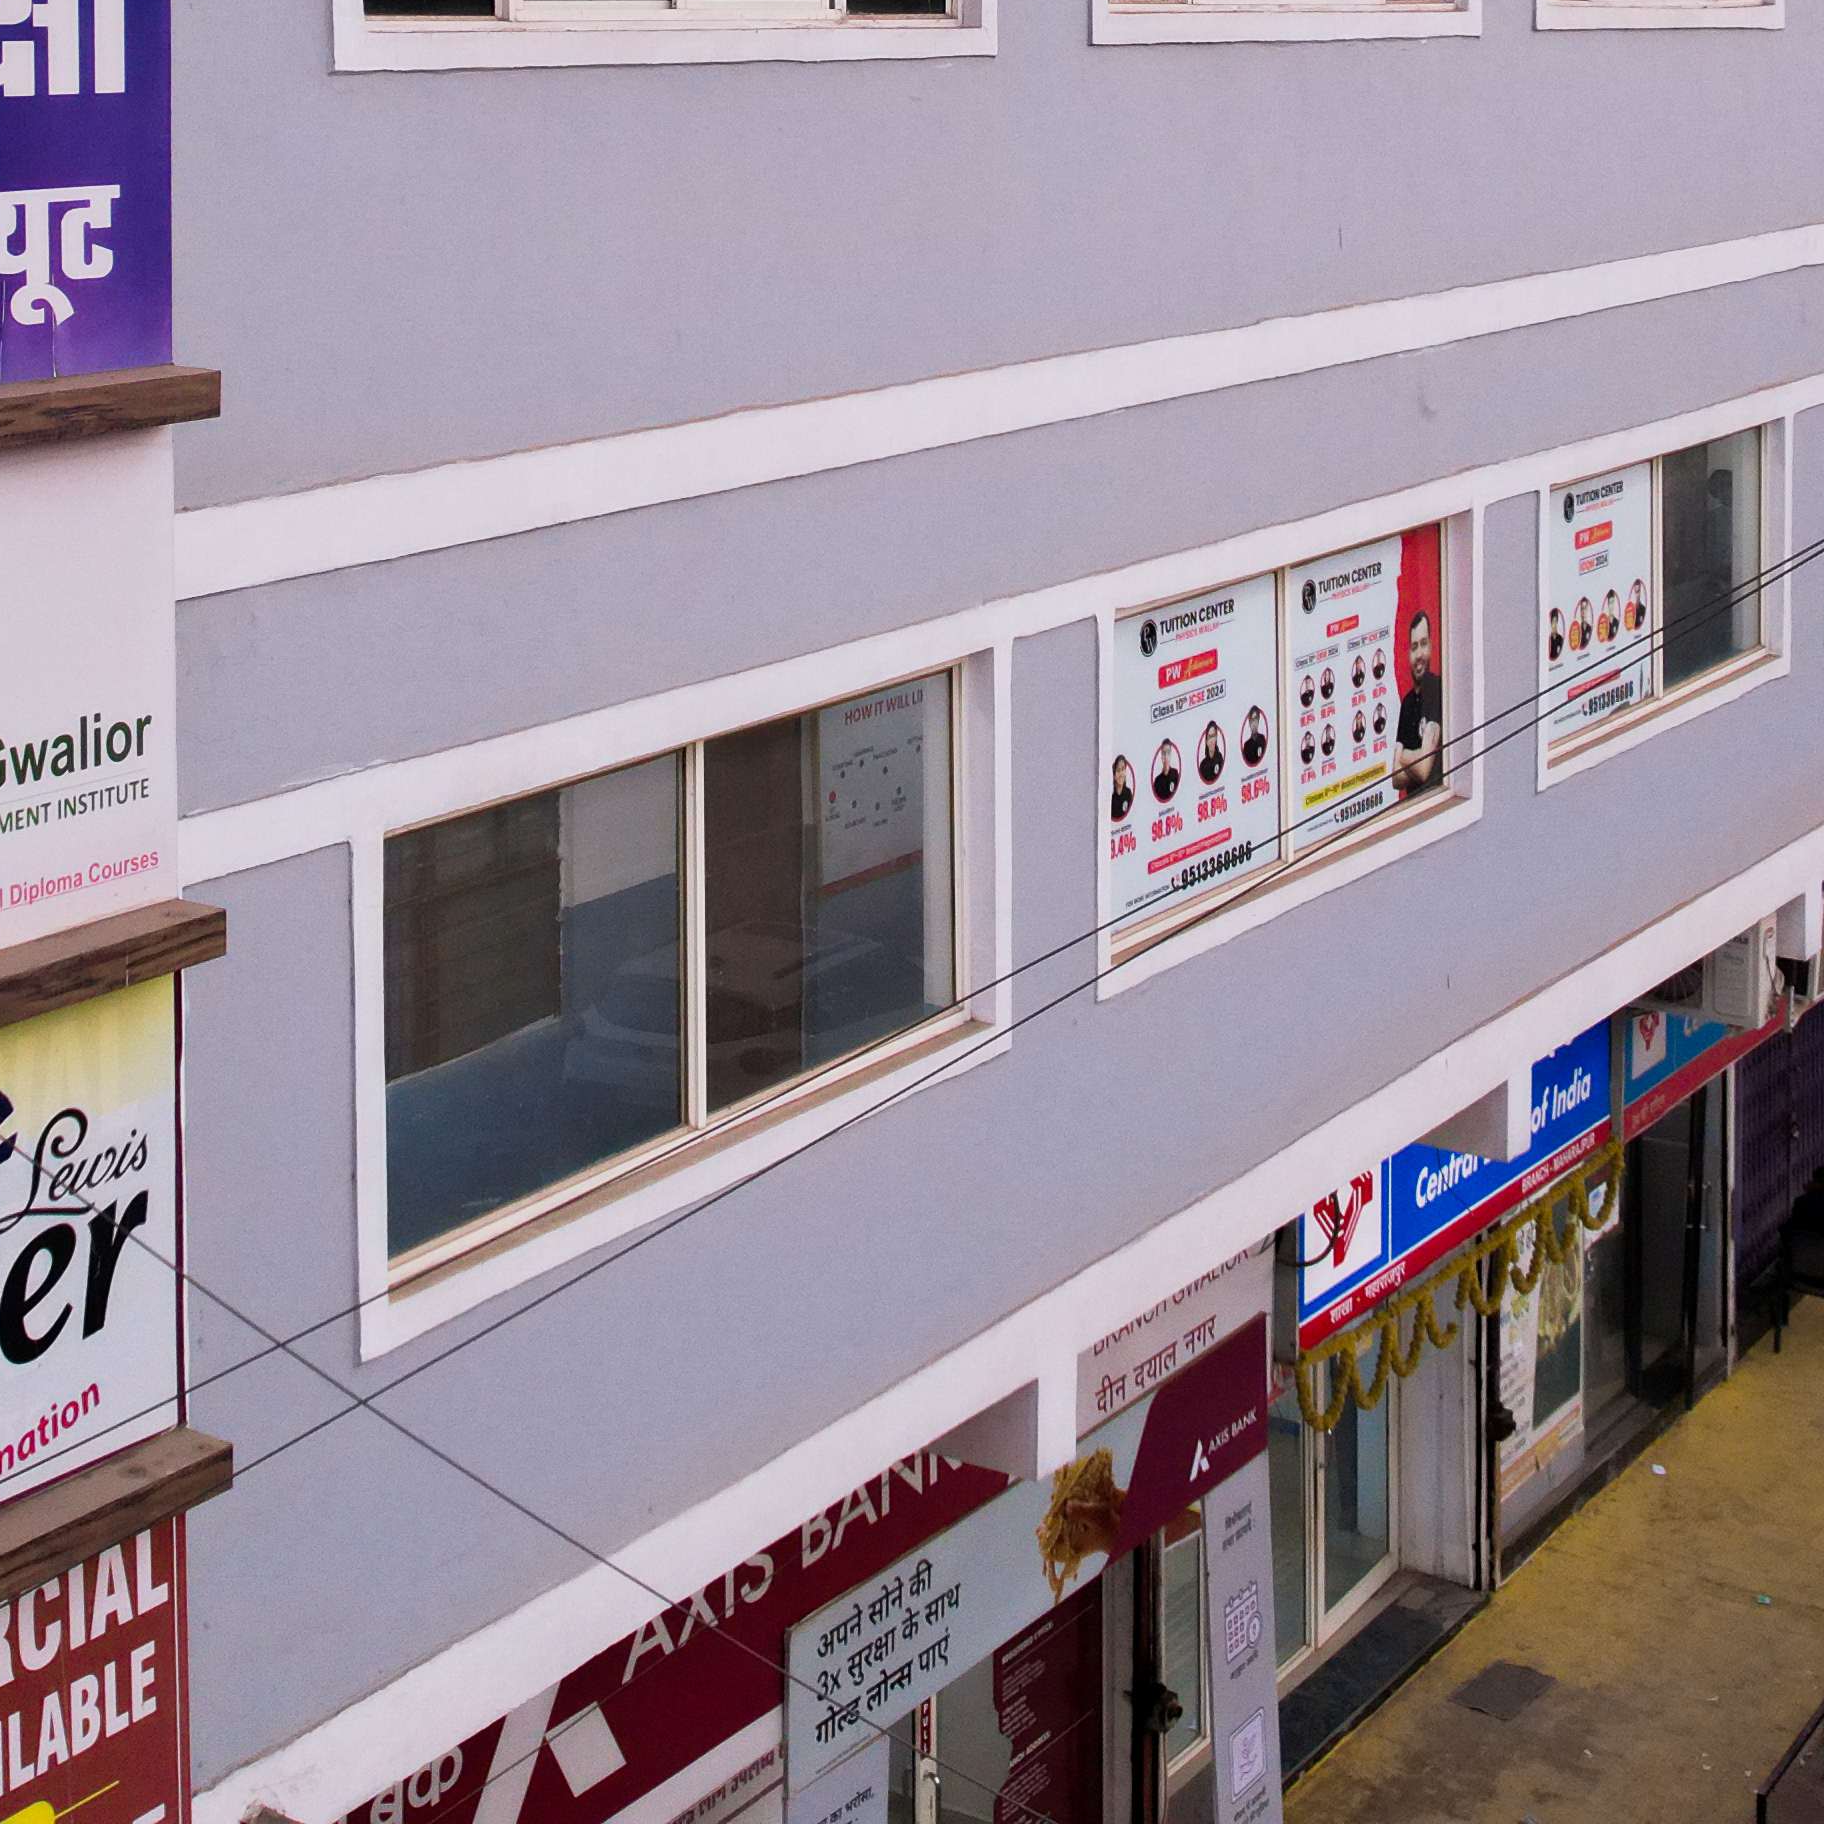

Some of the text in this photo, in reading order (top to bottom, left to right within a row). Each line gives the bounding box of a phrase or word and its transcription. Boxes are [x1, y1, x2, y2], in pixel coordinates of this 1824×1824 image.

[1319, 562, 1382, 594] TUITION CENTER
[1160, 598, 1234, 635] TUITION CENTER
[1166, 665, 1181, 682] PW
[844, 704, 872, 725] HOW
[875, 700, 885, 715] IT
[886, 693, 910, 712] WILL
[56, 778, 150, 819] INSTITUTE
[10, 869, 84, 912] Diploma
[88, 849, 159, 884] Courses
[1531, 1085, 1549, 1134] of
[1551, 1067, 1592, 1121] India
[1330, 1297, 1353, 1324] शाखा
[1095, 1314, 1217, 1413] दीन दयाल नगर
[1207, 1408, 1258, 1455] AXIS BANK
[621, 1551, 775, 1684] AXIS
[817, 1558, 933, 1658] अपने सोने की
[817, 1583, 961, 1701] 3x सुरक्षा के साथ
[815, 1697, 862, 1744] गोल्ड
[866, 1659, 913, 1713] लोन्स
[918, 1627, 951, 1673] पाएं
